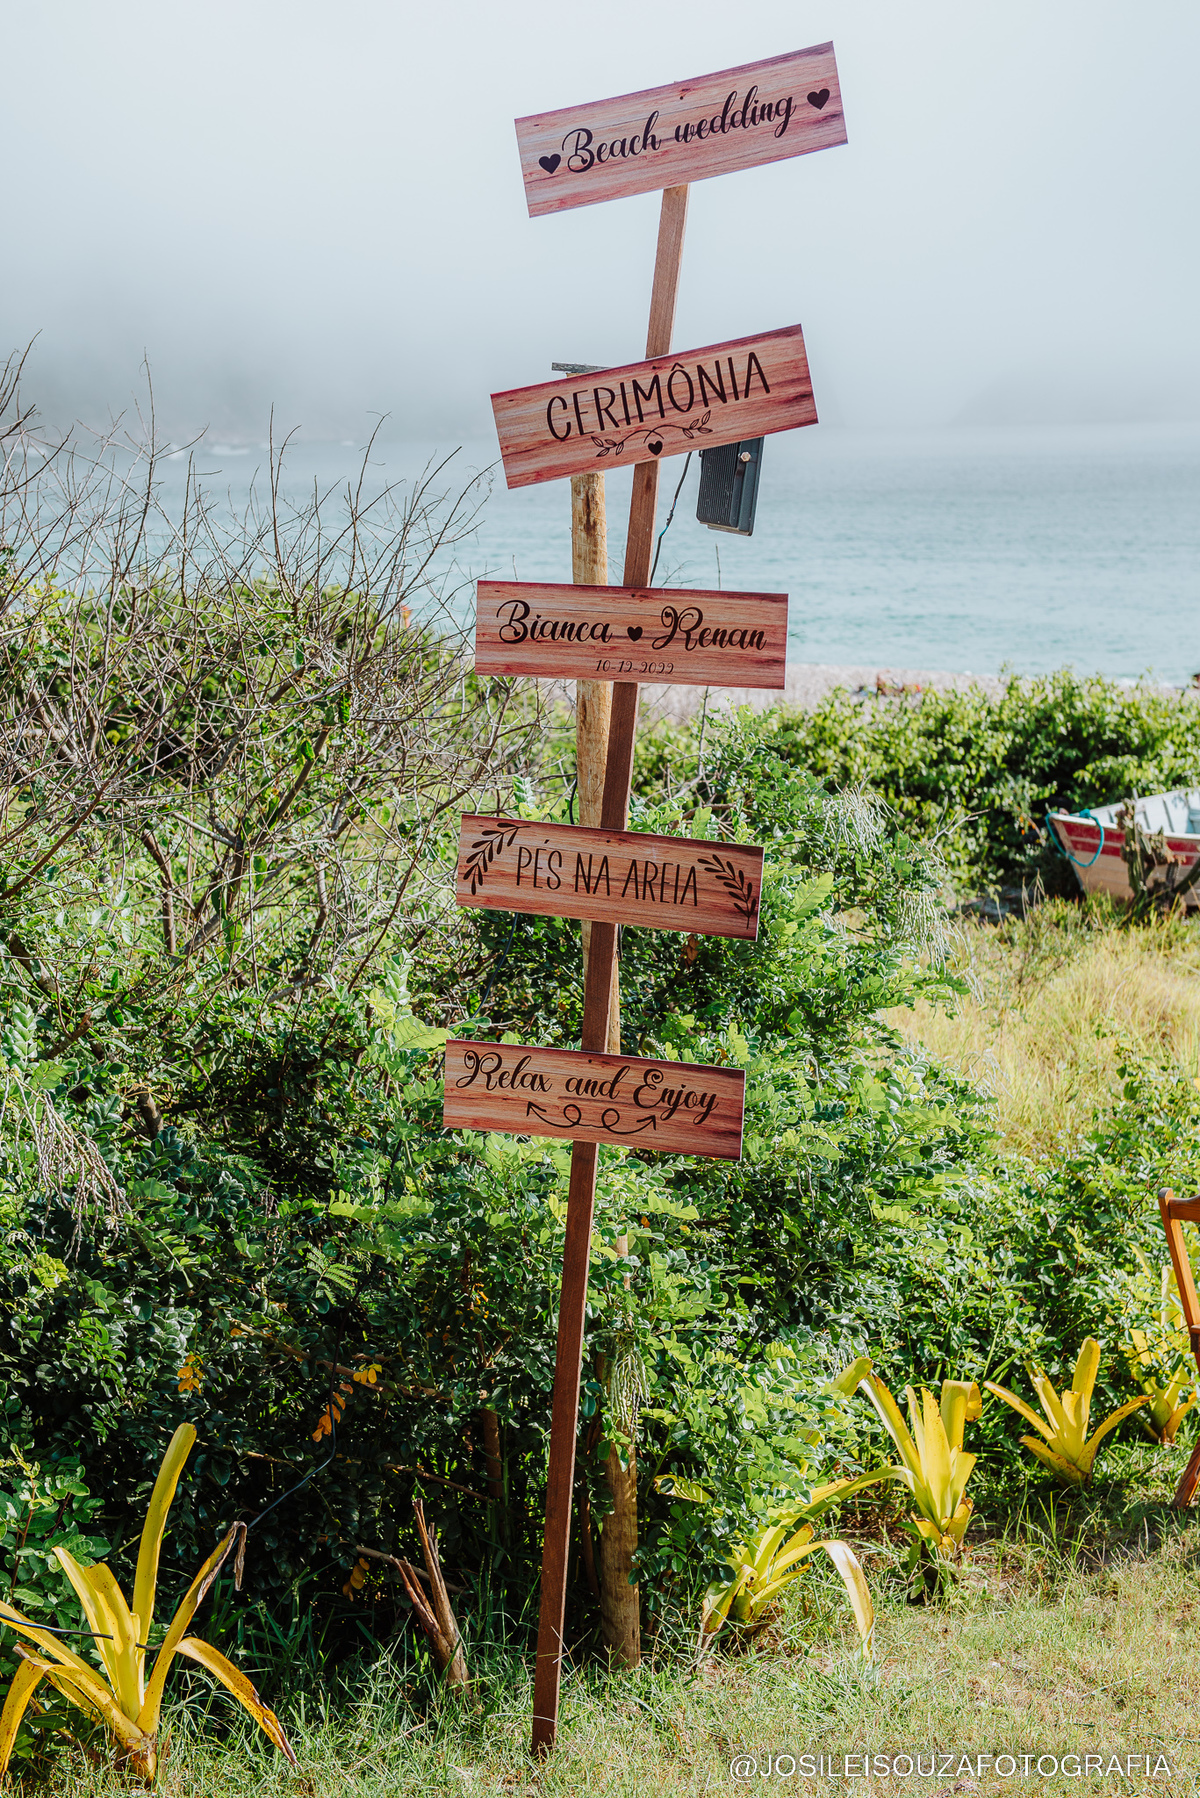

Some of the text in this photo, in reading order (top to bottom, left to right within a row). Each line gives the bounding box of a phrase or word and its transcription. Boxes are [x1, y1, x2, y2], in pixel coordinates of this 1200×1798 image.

[561, 85, 797, 173] Beach wedding
[546, 351, 770, 440] CERIMÔNIA
[496, 599, 767, 651] Bianca Renan
[595, 659, 674, 674] 10-12-2022
[516, 839, 698, 906] PÉS NA AREIA
[455, 1050, 719, 1125] Relax and Enjoy
